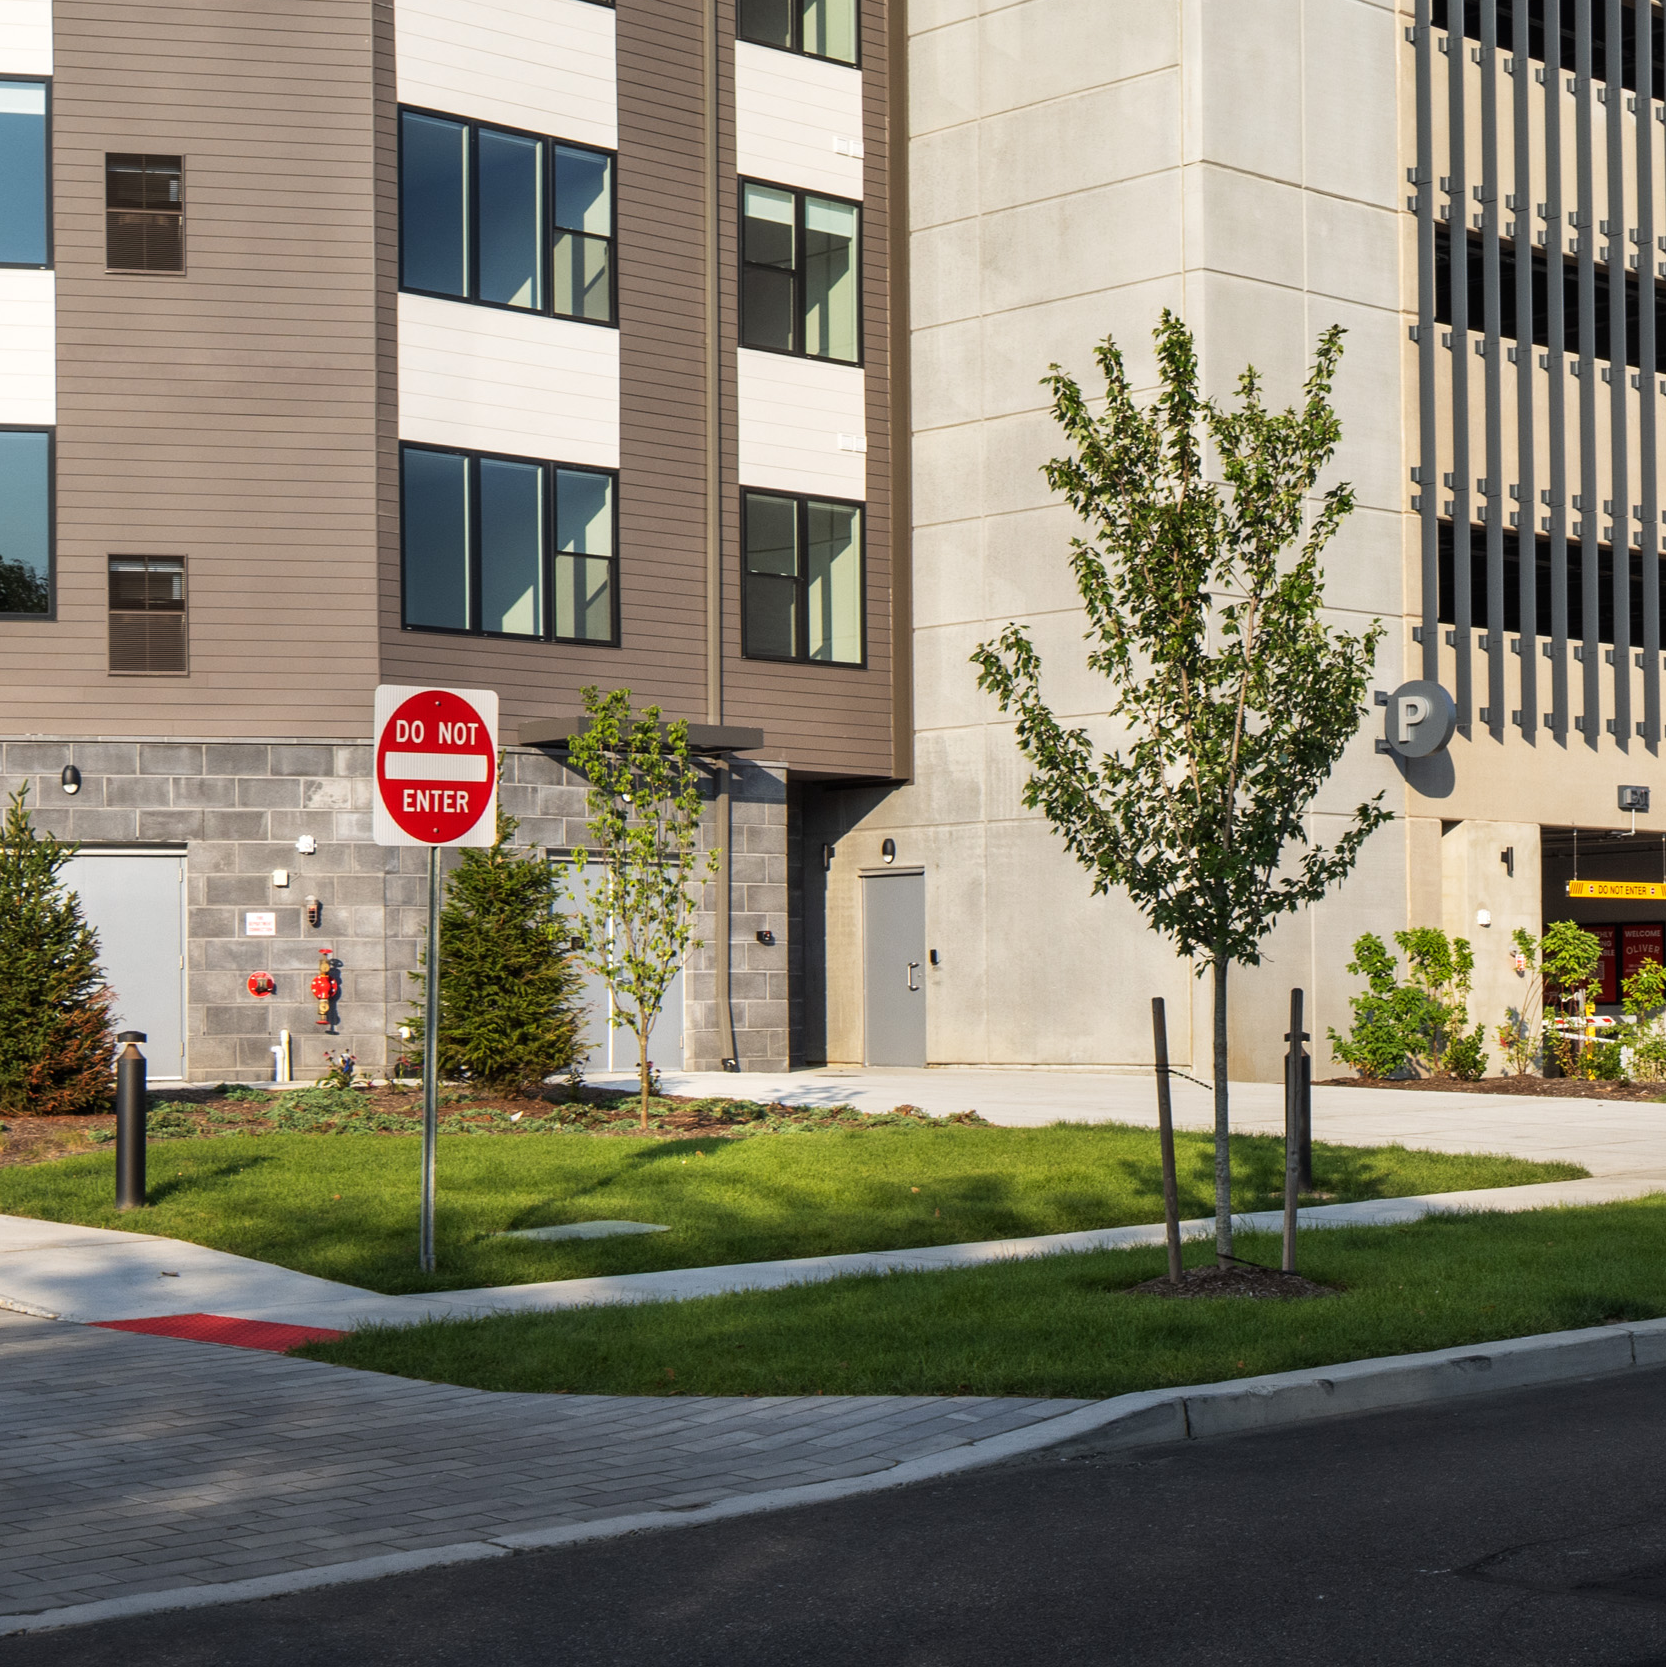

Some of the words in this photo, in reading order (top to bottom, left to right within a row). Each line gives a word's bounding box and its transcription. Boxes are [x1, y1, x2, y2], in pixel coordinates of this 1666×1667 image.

[1397, 695, 1430, 743] P
[396, 720, 424, 743] DO
[438, 721, 479, 746] NOT
[403, 790, 468, 813] ENTER
[1598, 885, 1608, 894] DO
[1610, 885, 1623, 895] NOT
[1625, 886, 1647, 895] ENTER
[1624, 929, 1662, 938] WELCOME
[1625, 944, 1661, 955] OLIVER
